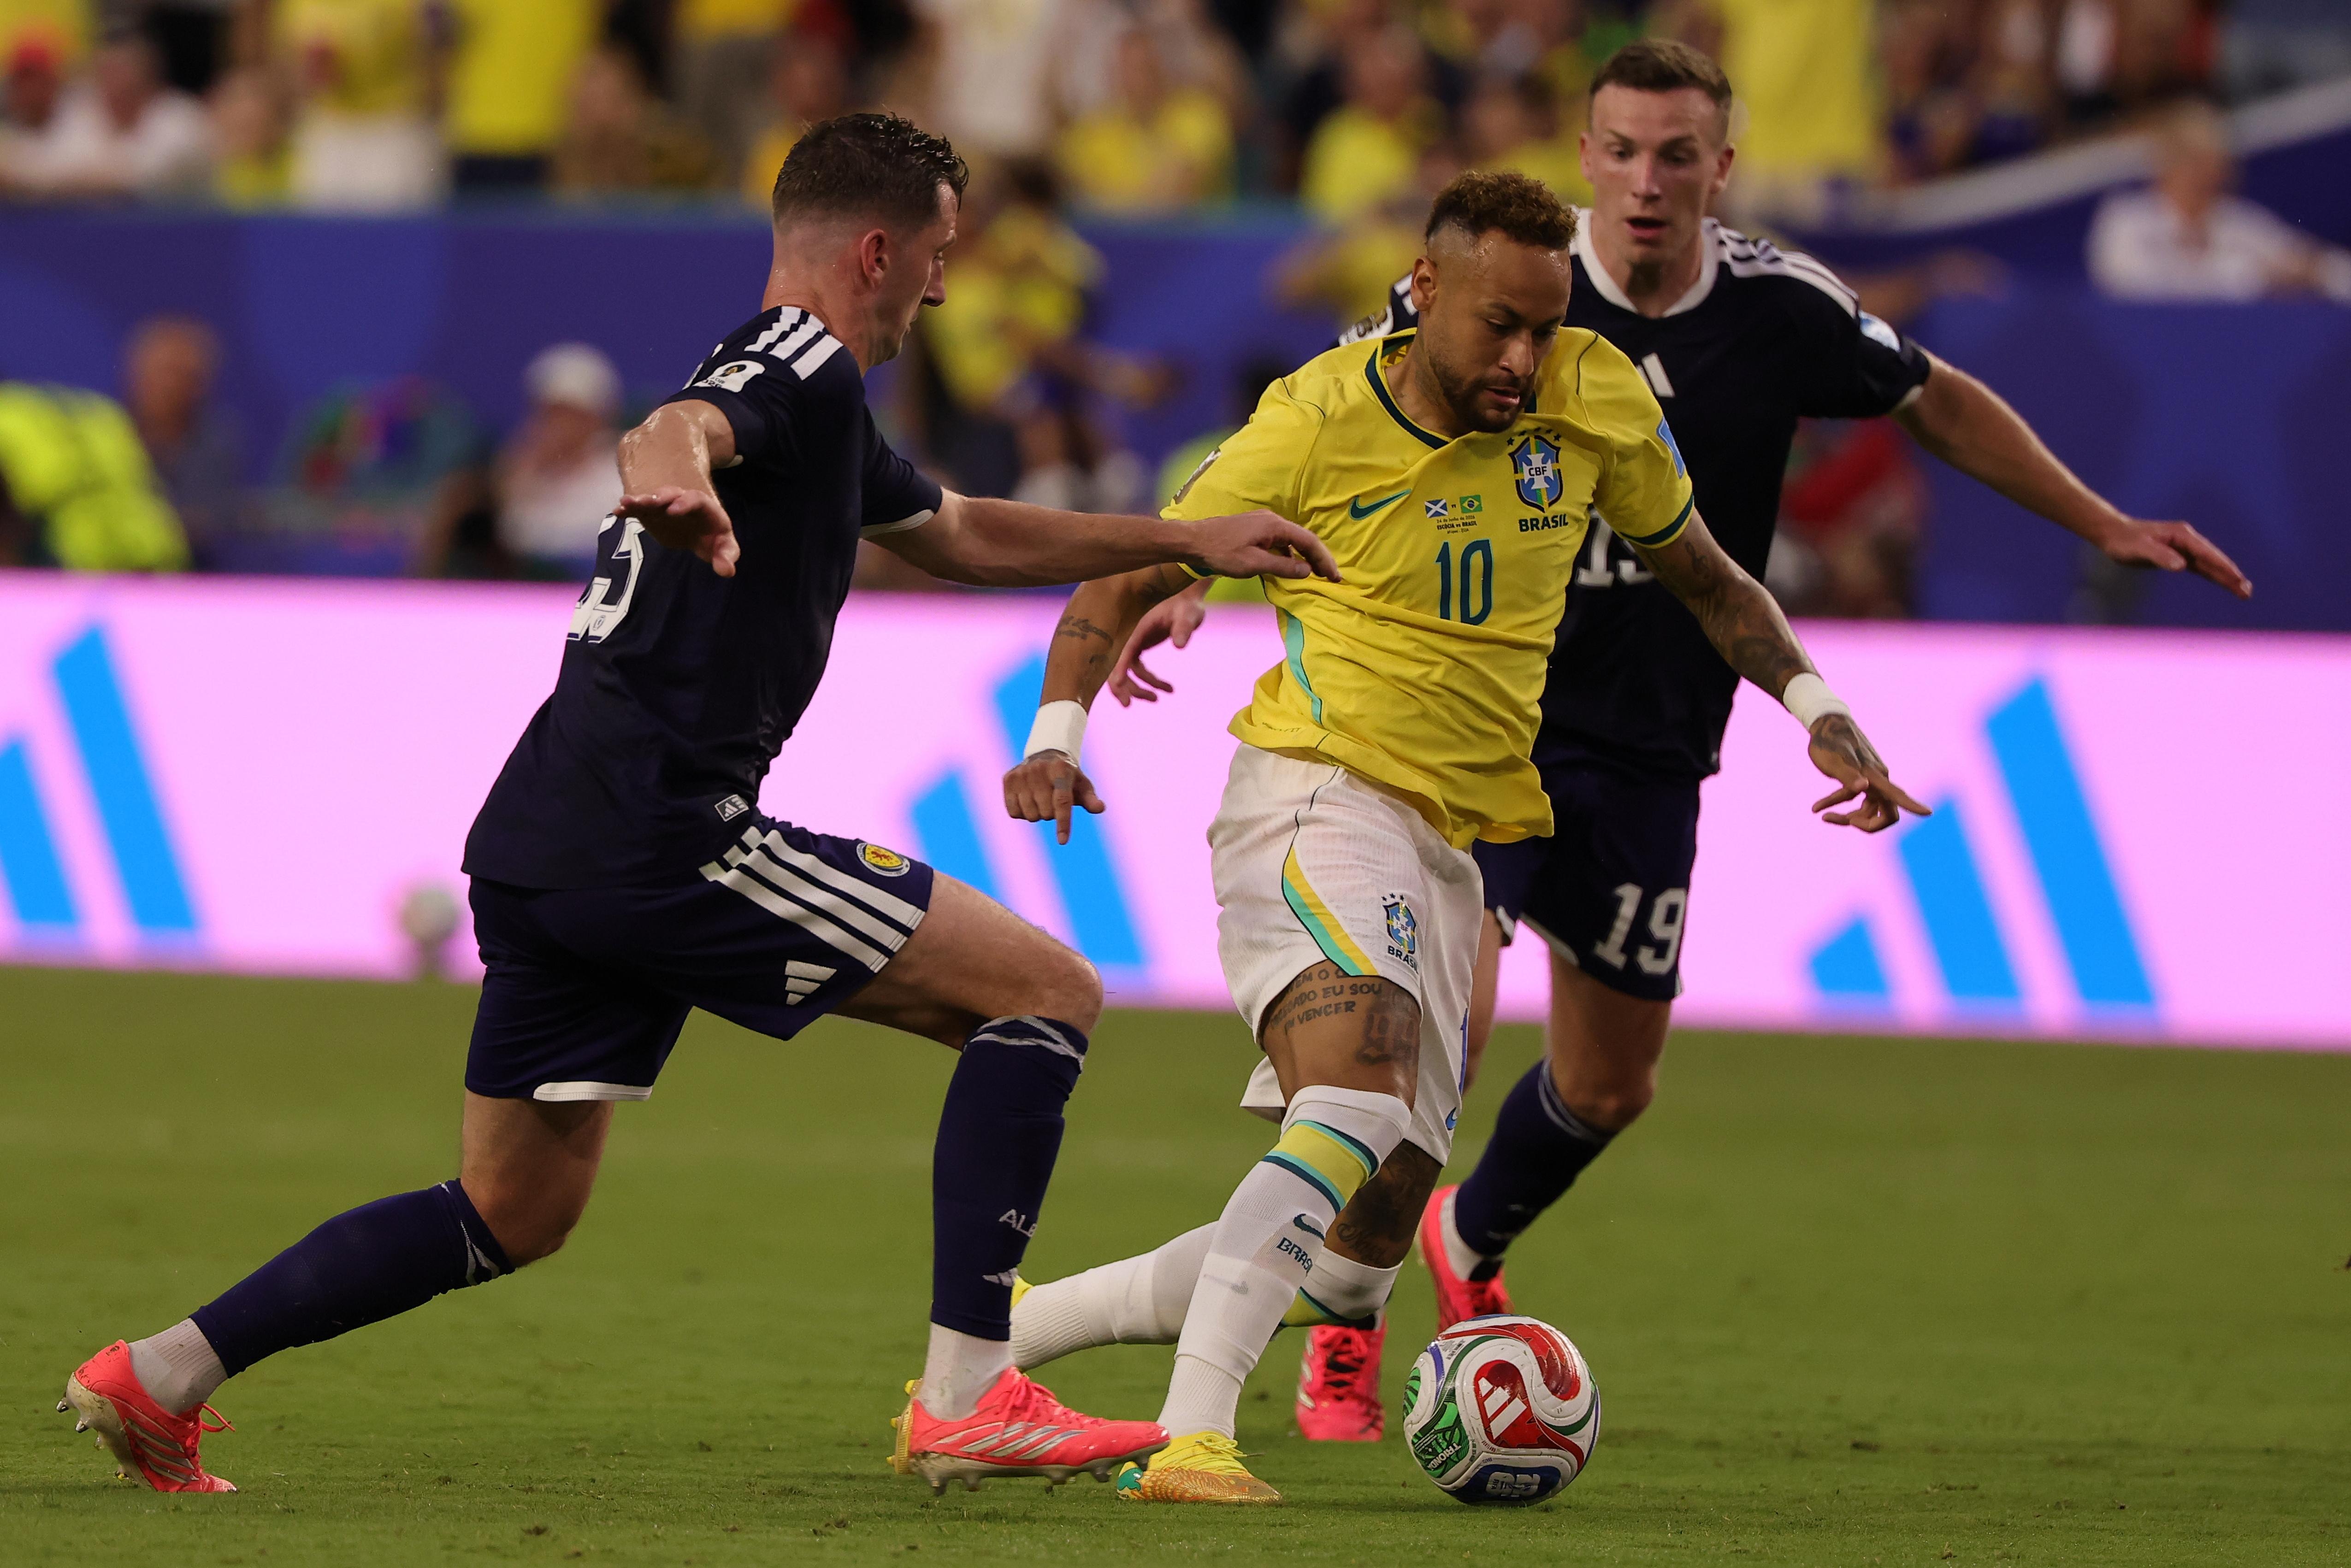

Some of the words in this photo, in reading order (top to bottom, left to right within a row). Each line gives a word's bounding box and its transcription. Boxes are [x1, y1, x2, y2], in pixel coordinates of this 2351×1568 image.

[1529, 466, 1547, 477] CBF
[1518, 514, 1568, 532] BRASIL
[1435, 538, 1494, 625] 10
[1593, 882, 1687, 976] 19
[1349, 983, 1382, 996] SOU
[1297, 1001, 1356, 1024] VENCER
